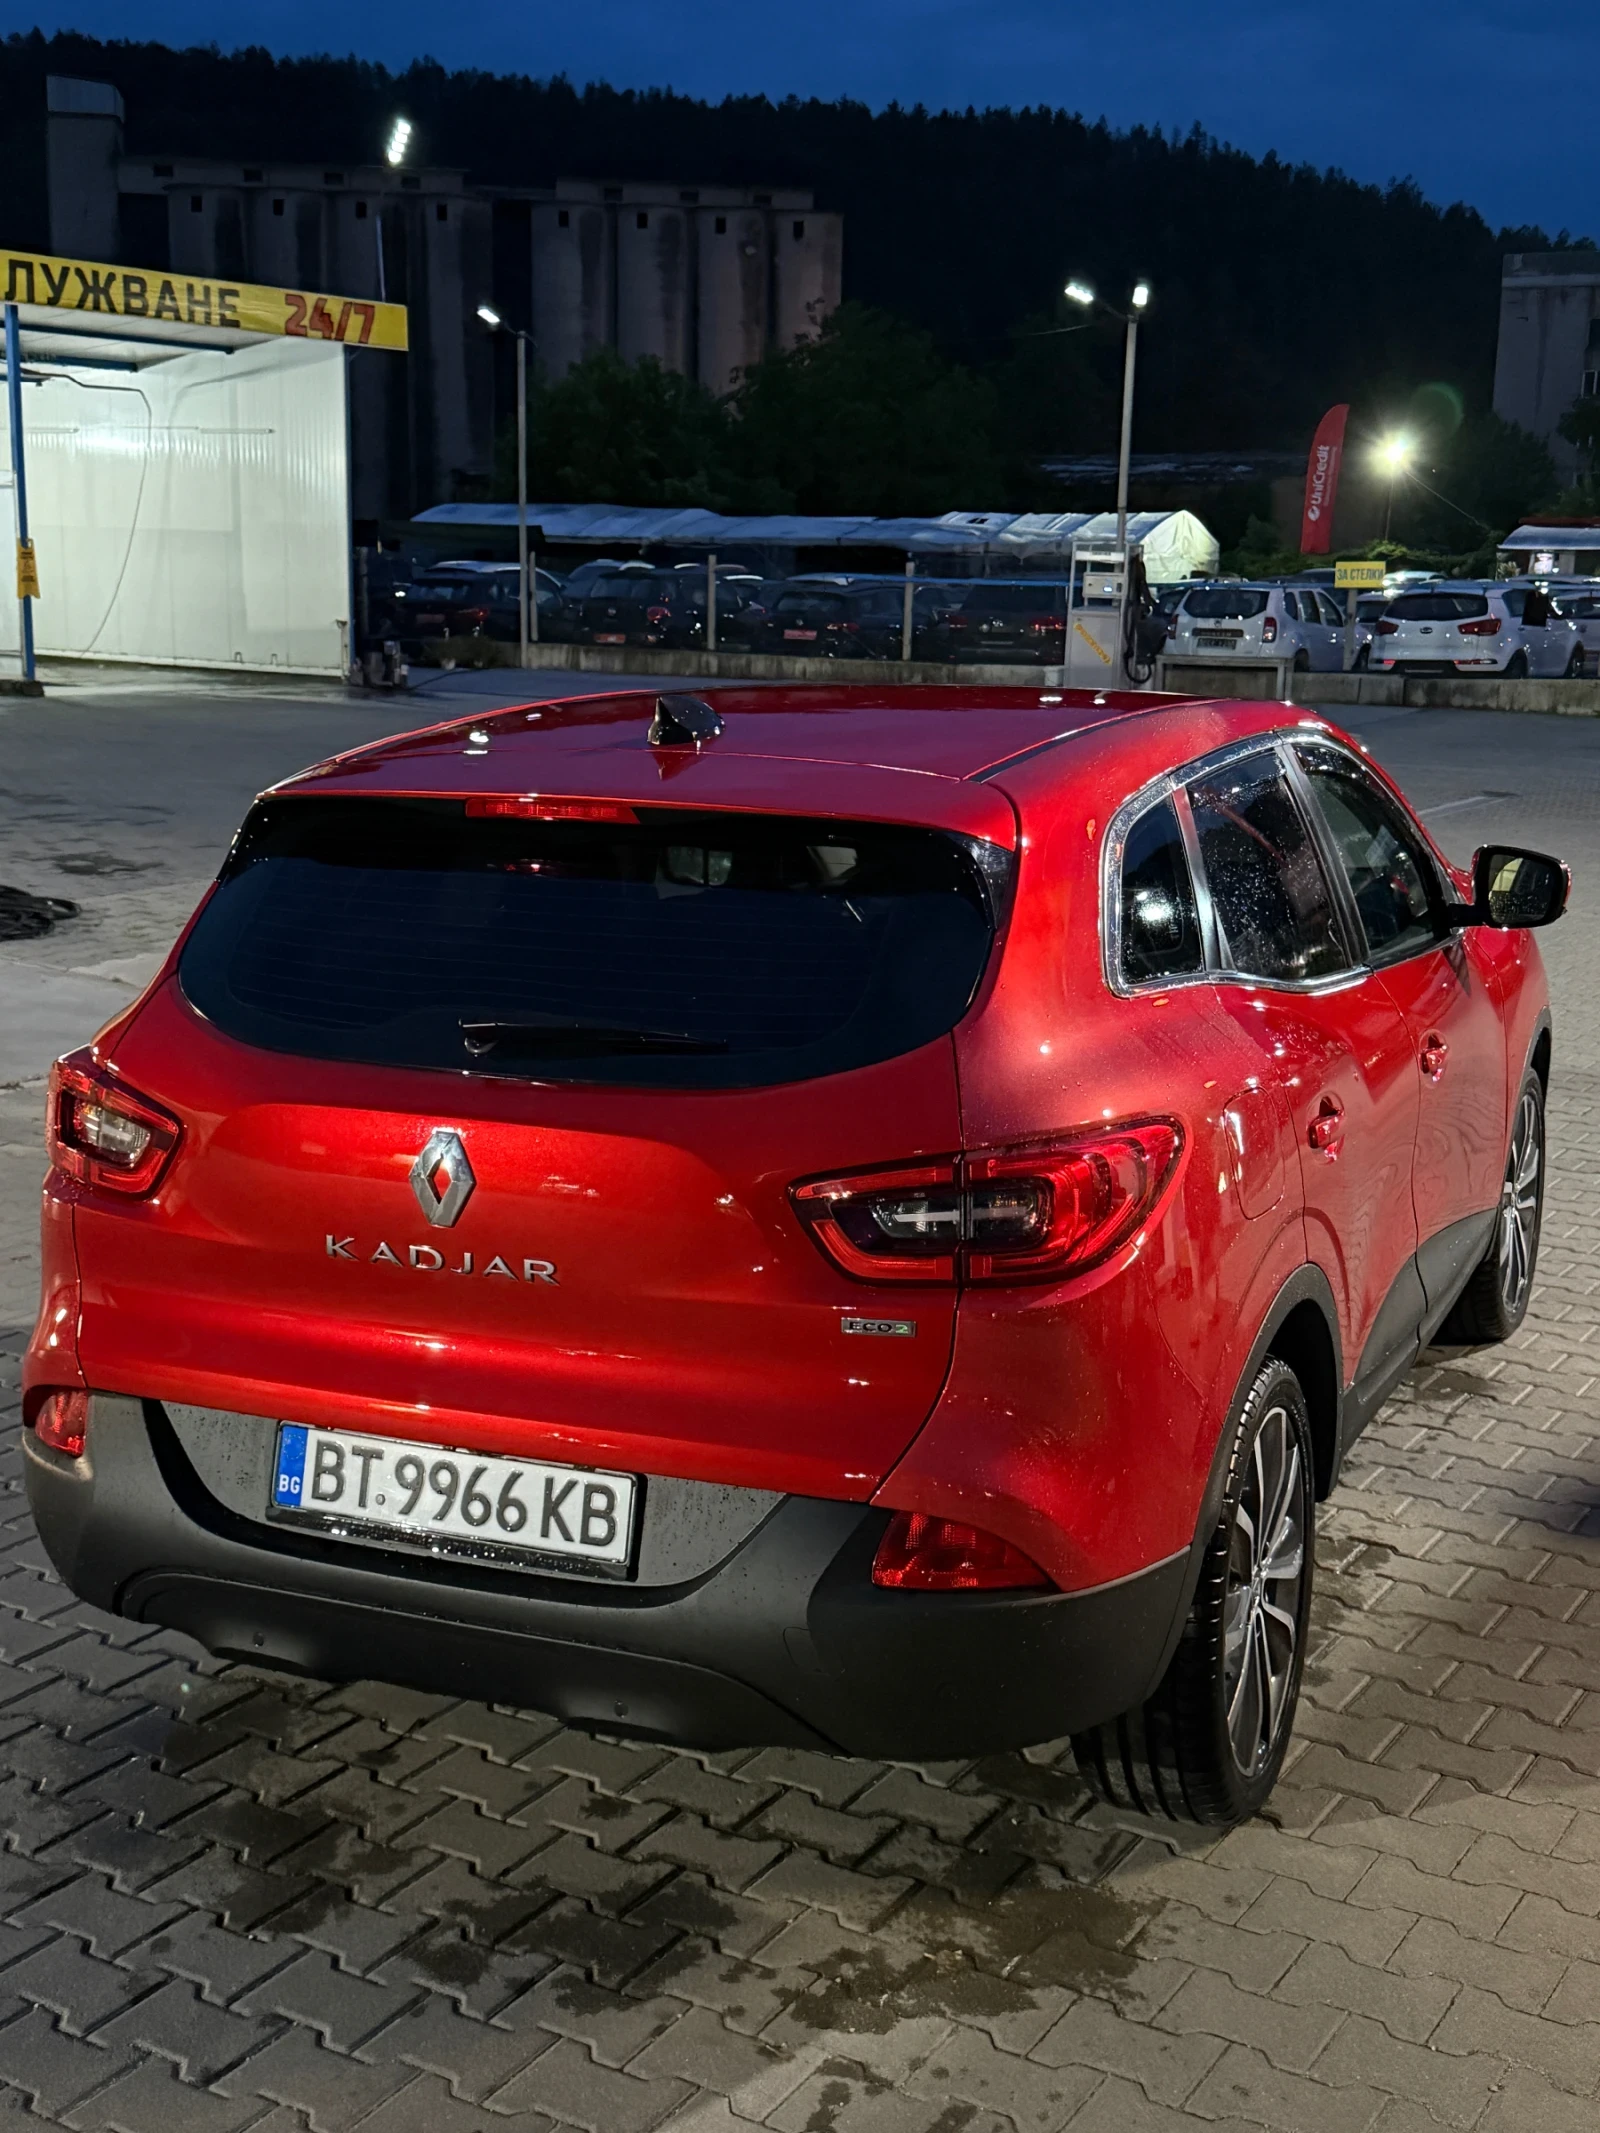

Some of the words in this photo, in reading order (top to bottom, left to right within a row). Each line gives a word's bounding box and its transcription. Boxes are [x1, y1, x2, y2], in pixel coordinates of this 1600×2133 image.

[5, 259, 241, 328] ЛУЖВАНЕ
[284, 294, 375, 344] 24/7
[1310, 444, 1330, 505] UniCredit
[325, 1233, 561, 1287] KADJAR
[279, 1474, 301, 1494] BG
